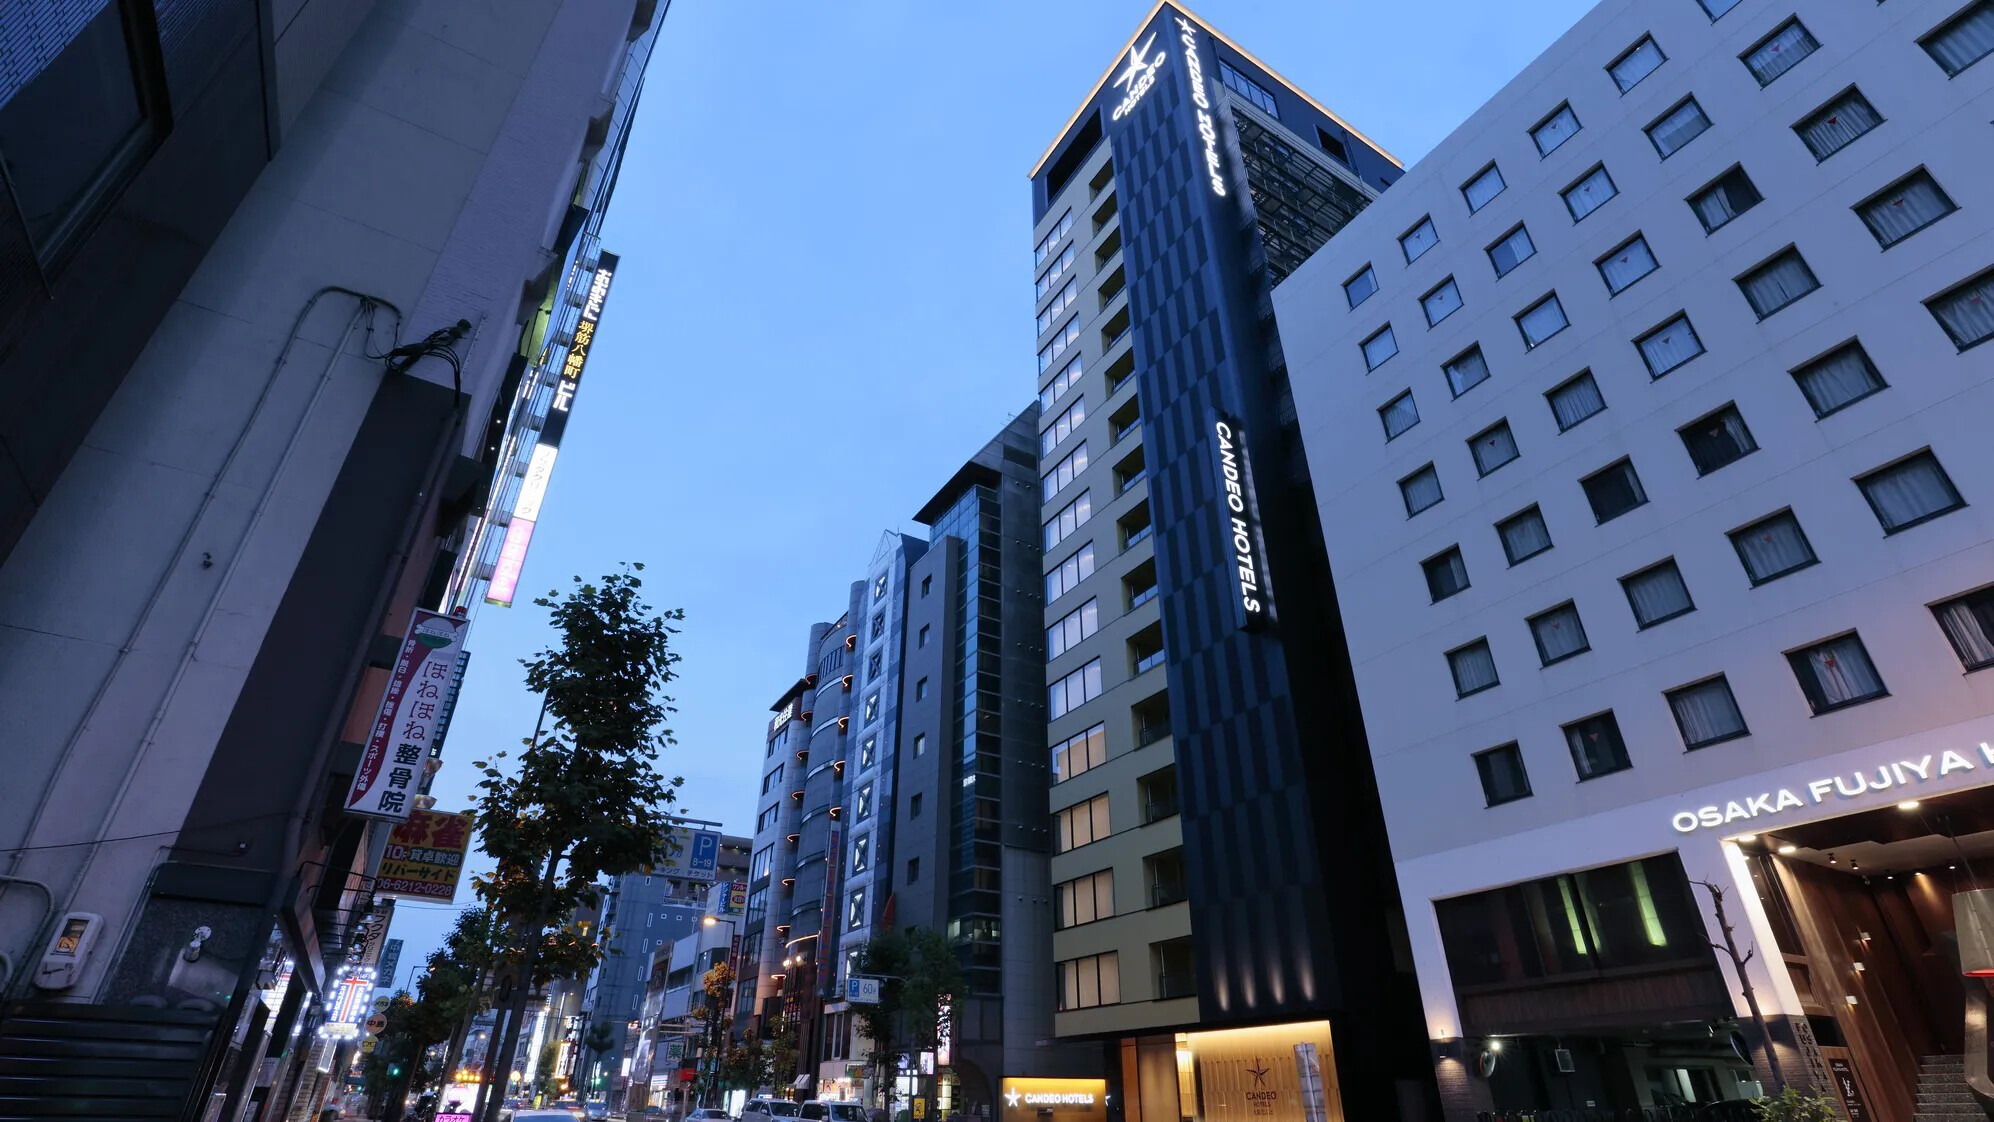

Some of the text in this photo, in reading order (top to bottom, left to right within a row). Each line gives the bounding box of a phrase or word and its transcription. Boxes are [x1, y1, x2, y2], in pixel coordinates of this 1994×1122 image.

[1112, 51, 1166, 121] CANDEO
[1182, 34, 1226, 197] CANDEO HOTELS
[1216, 421, 1261, 613] CANDEO HOTELS
[1672, 789, 1804, 833] OSAKA
[1808, 750, 1975, 803] FUJIYA
[699, 836, 713, 856] P
[382, 862, 457, 881] リバーサイド
[1024, 1092, 1094, 1104] CANDEO HOTELS
[1245, 1091, 1277, 1100] CANDEO
